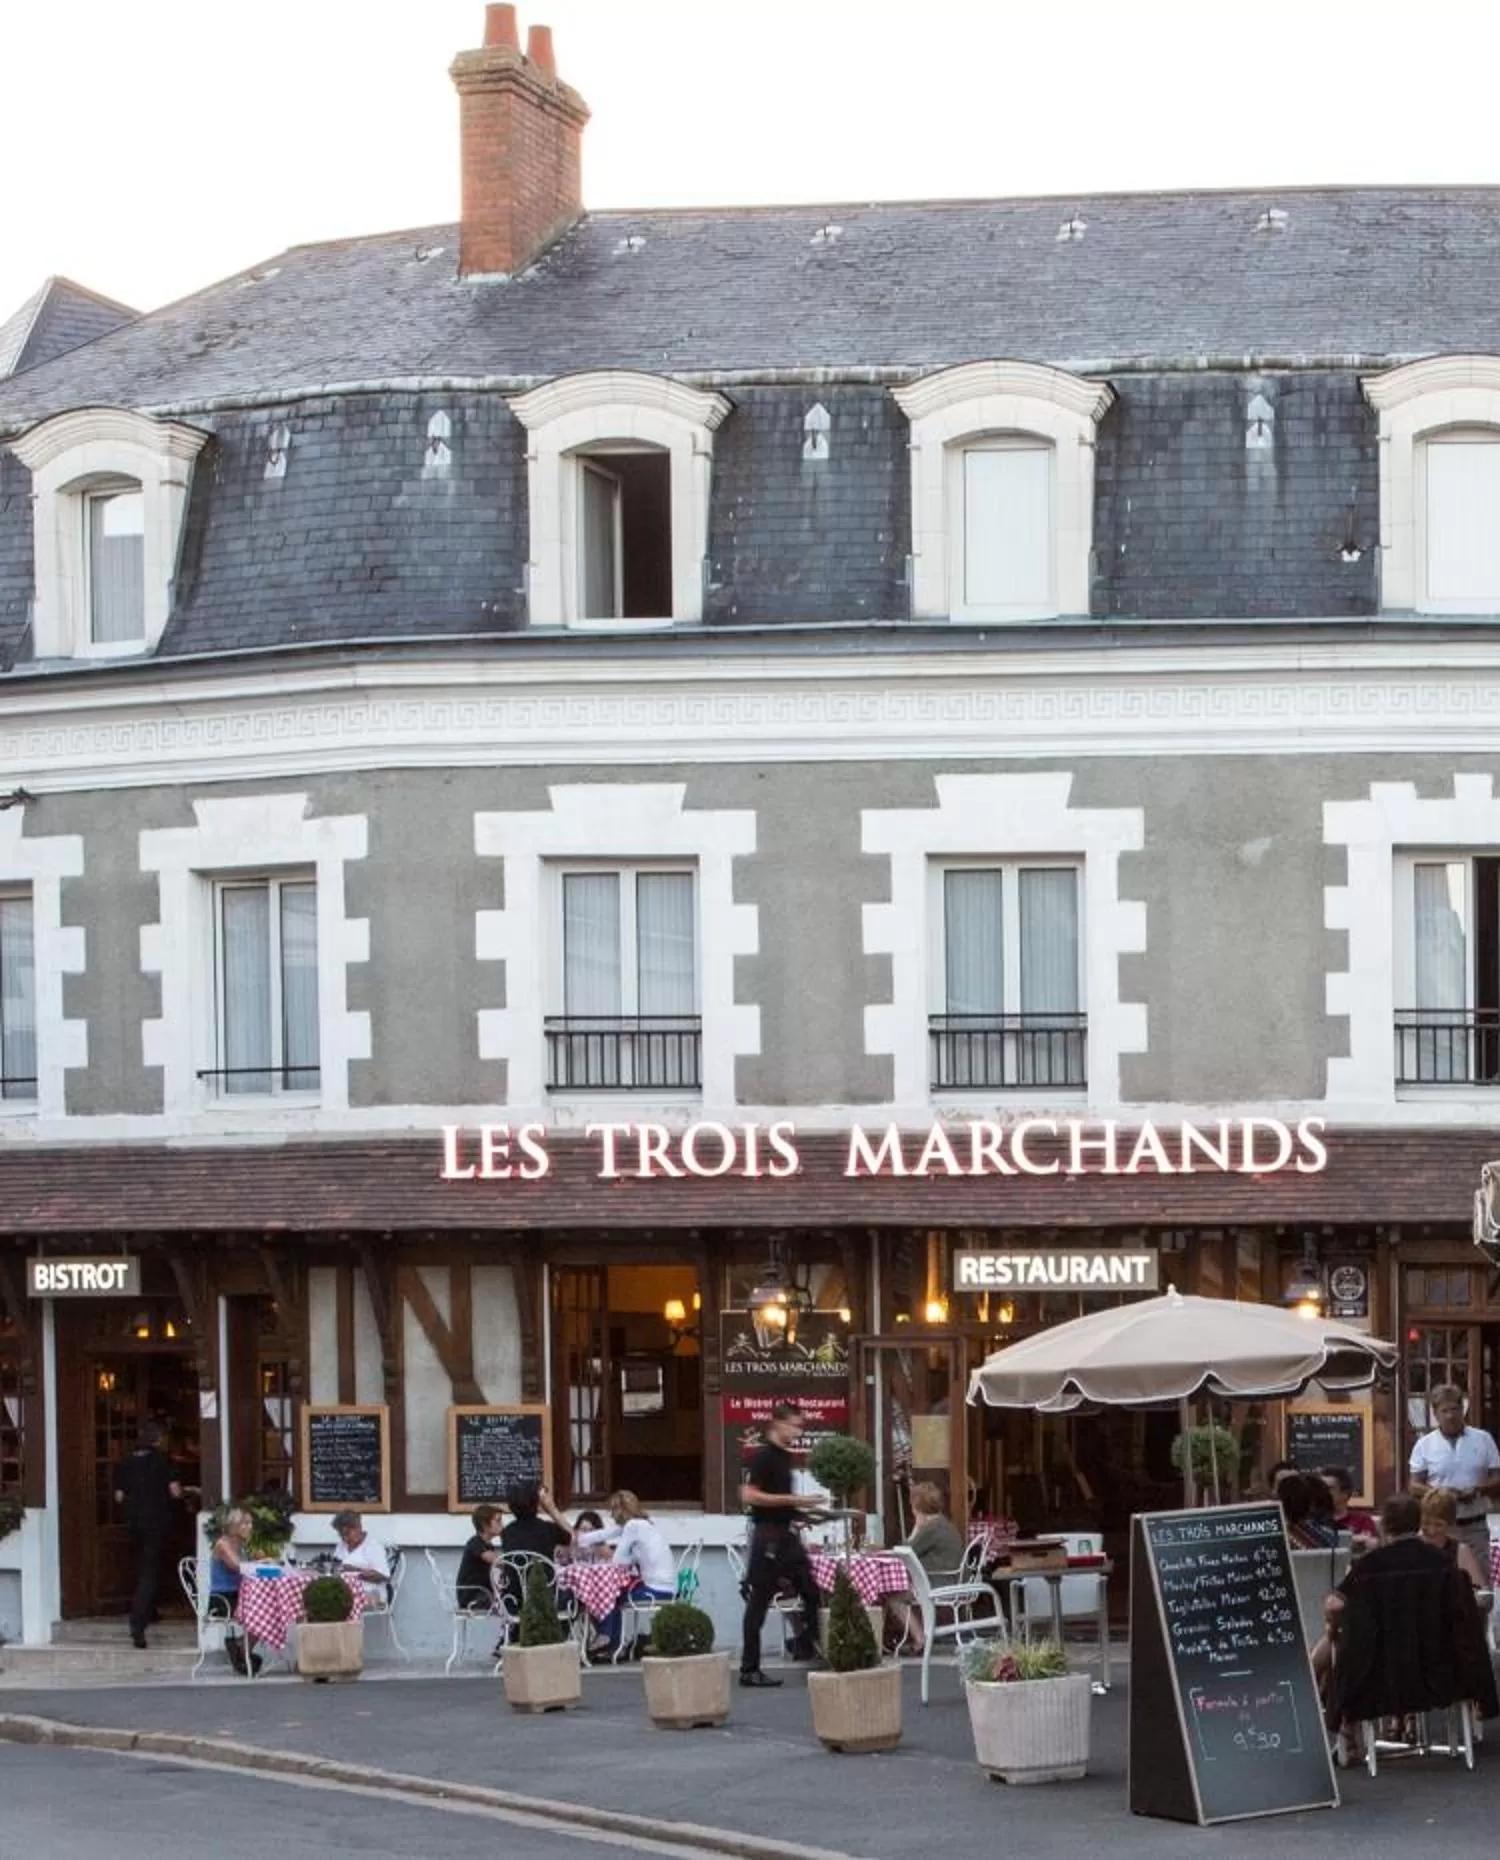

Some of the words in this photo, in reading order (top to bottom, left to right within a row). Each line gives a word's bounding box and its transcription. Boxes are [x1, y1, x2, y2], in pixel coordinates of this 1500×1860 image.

[440, 1123, 550, 1179] LES
[585, 1120, 800, 1178] TROIS
[843, 1116, 1328, 1177] MARCHANDS
[34, 1263, 128, 1290] BISTROT
[960, 1256, 1149, 1284] RESTAURANT
[725, 1361, 742, 1373] LES
[744, 1361, 777, 1373] TROIS
[779, 1360, 848, 1373] MARCHANDS
[1152, 1527, 1174, 1543] LES
[1215, 1519, 1278, 1536] MARCHANDS
